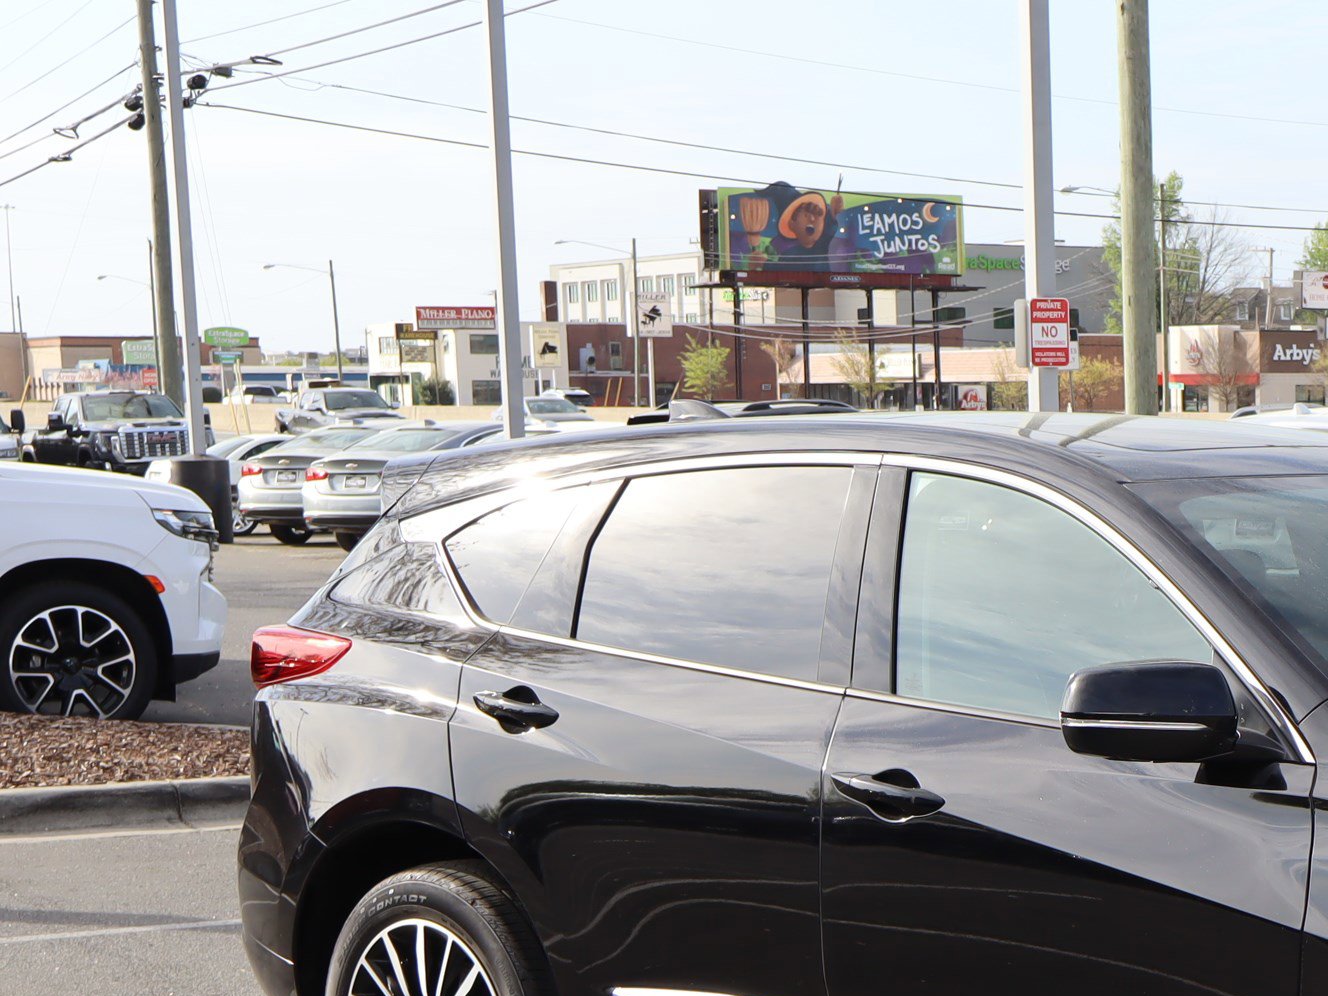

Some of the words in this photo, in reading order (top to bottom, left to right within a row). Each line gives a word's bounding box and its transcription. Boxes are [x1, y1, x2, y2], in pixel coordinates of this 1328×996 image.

[1036, 301, 1062, 309] PRIVATE
[420, 308, 456, 319] MILLER
[1032, 311, 1066, 319] PROPERTY
[1041, 325, 1058, 338] NO
[1273, 343, 1321, 366] Arby's
